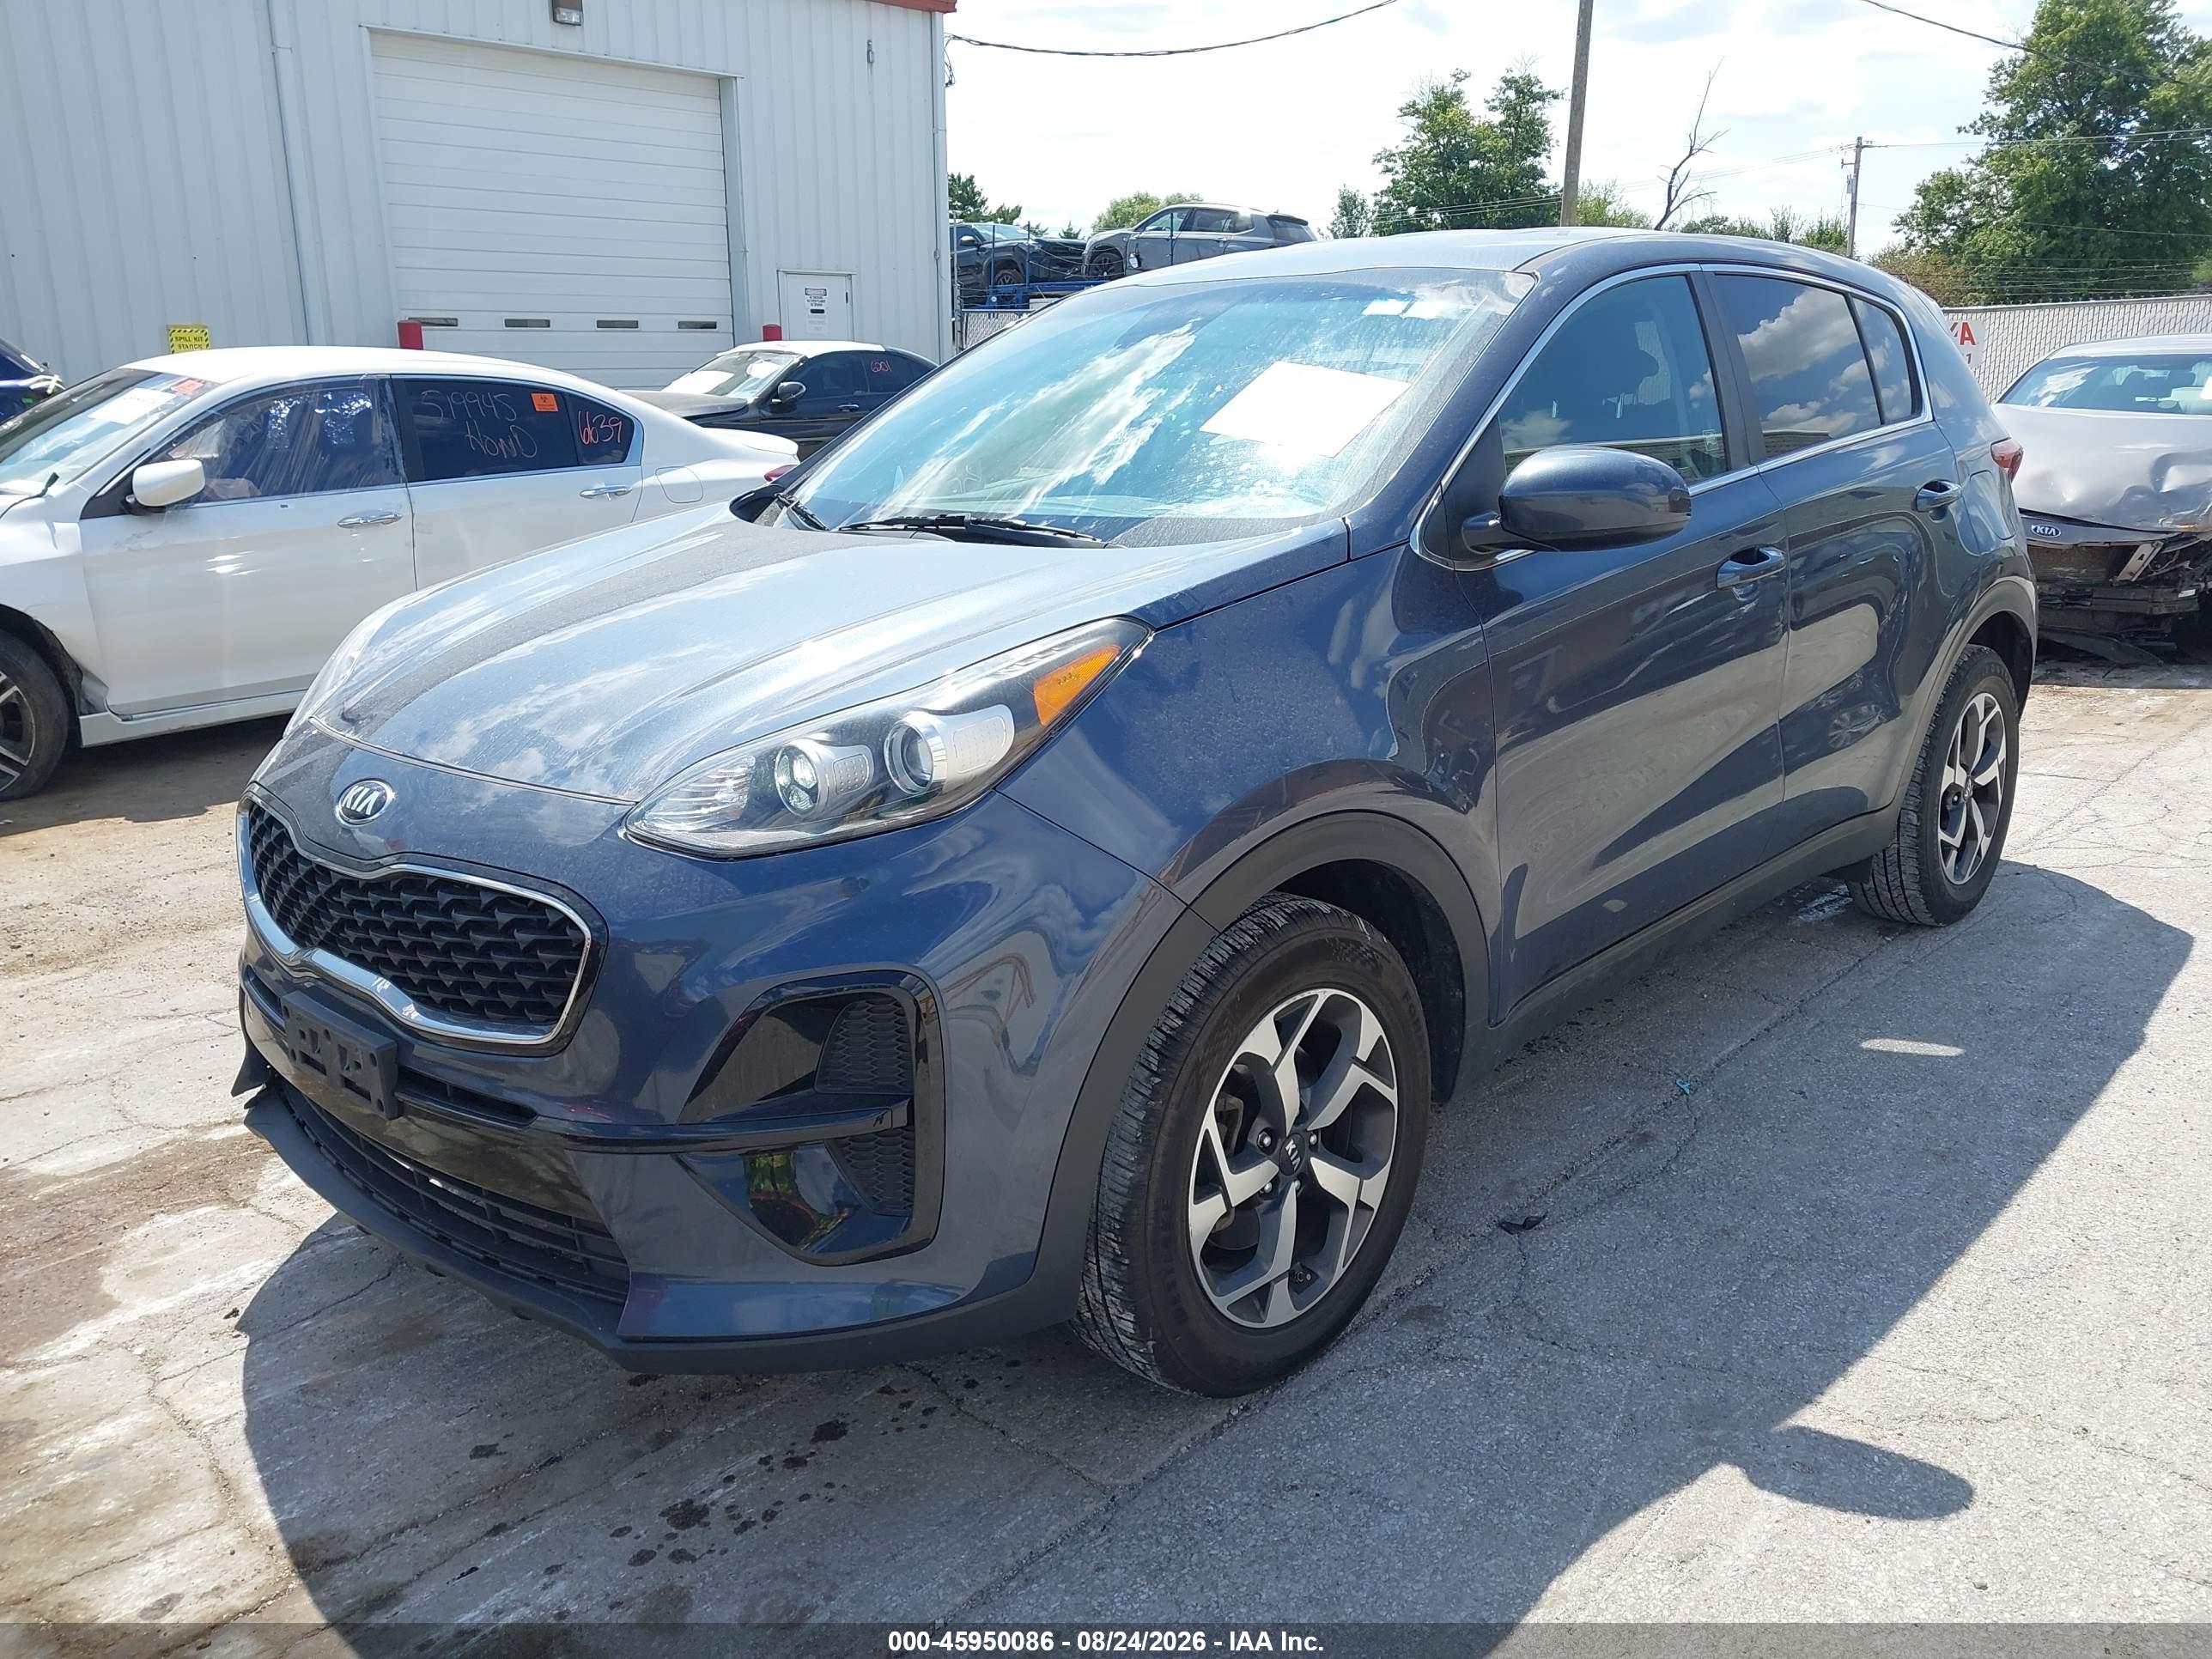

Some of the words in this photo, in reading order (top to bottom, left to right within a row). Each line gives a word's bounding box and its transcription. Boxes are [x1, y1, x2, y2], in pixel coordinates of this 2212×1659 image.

[2036, 526, 2057, 536] KIA
[341, 785, 380, 816] KIA
[1285, 1138, 1301, 1171] KIA
